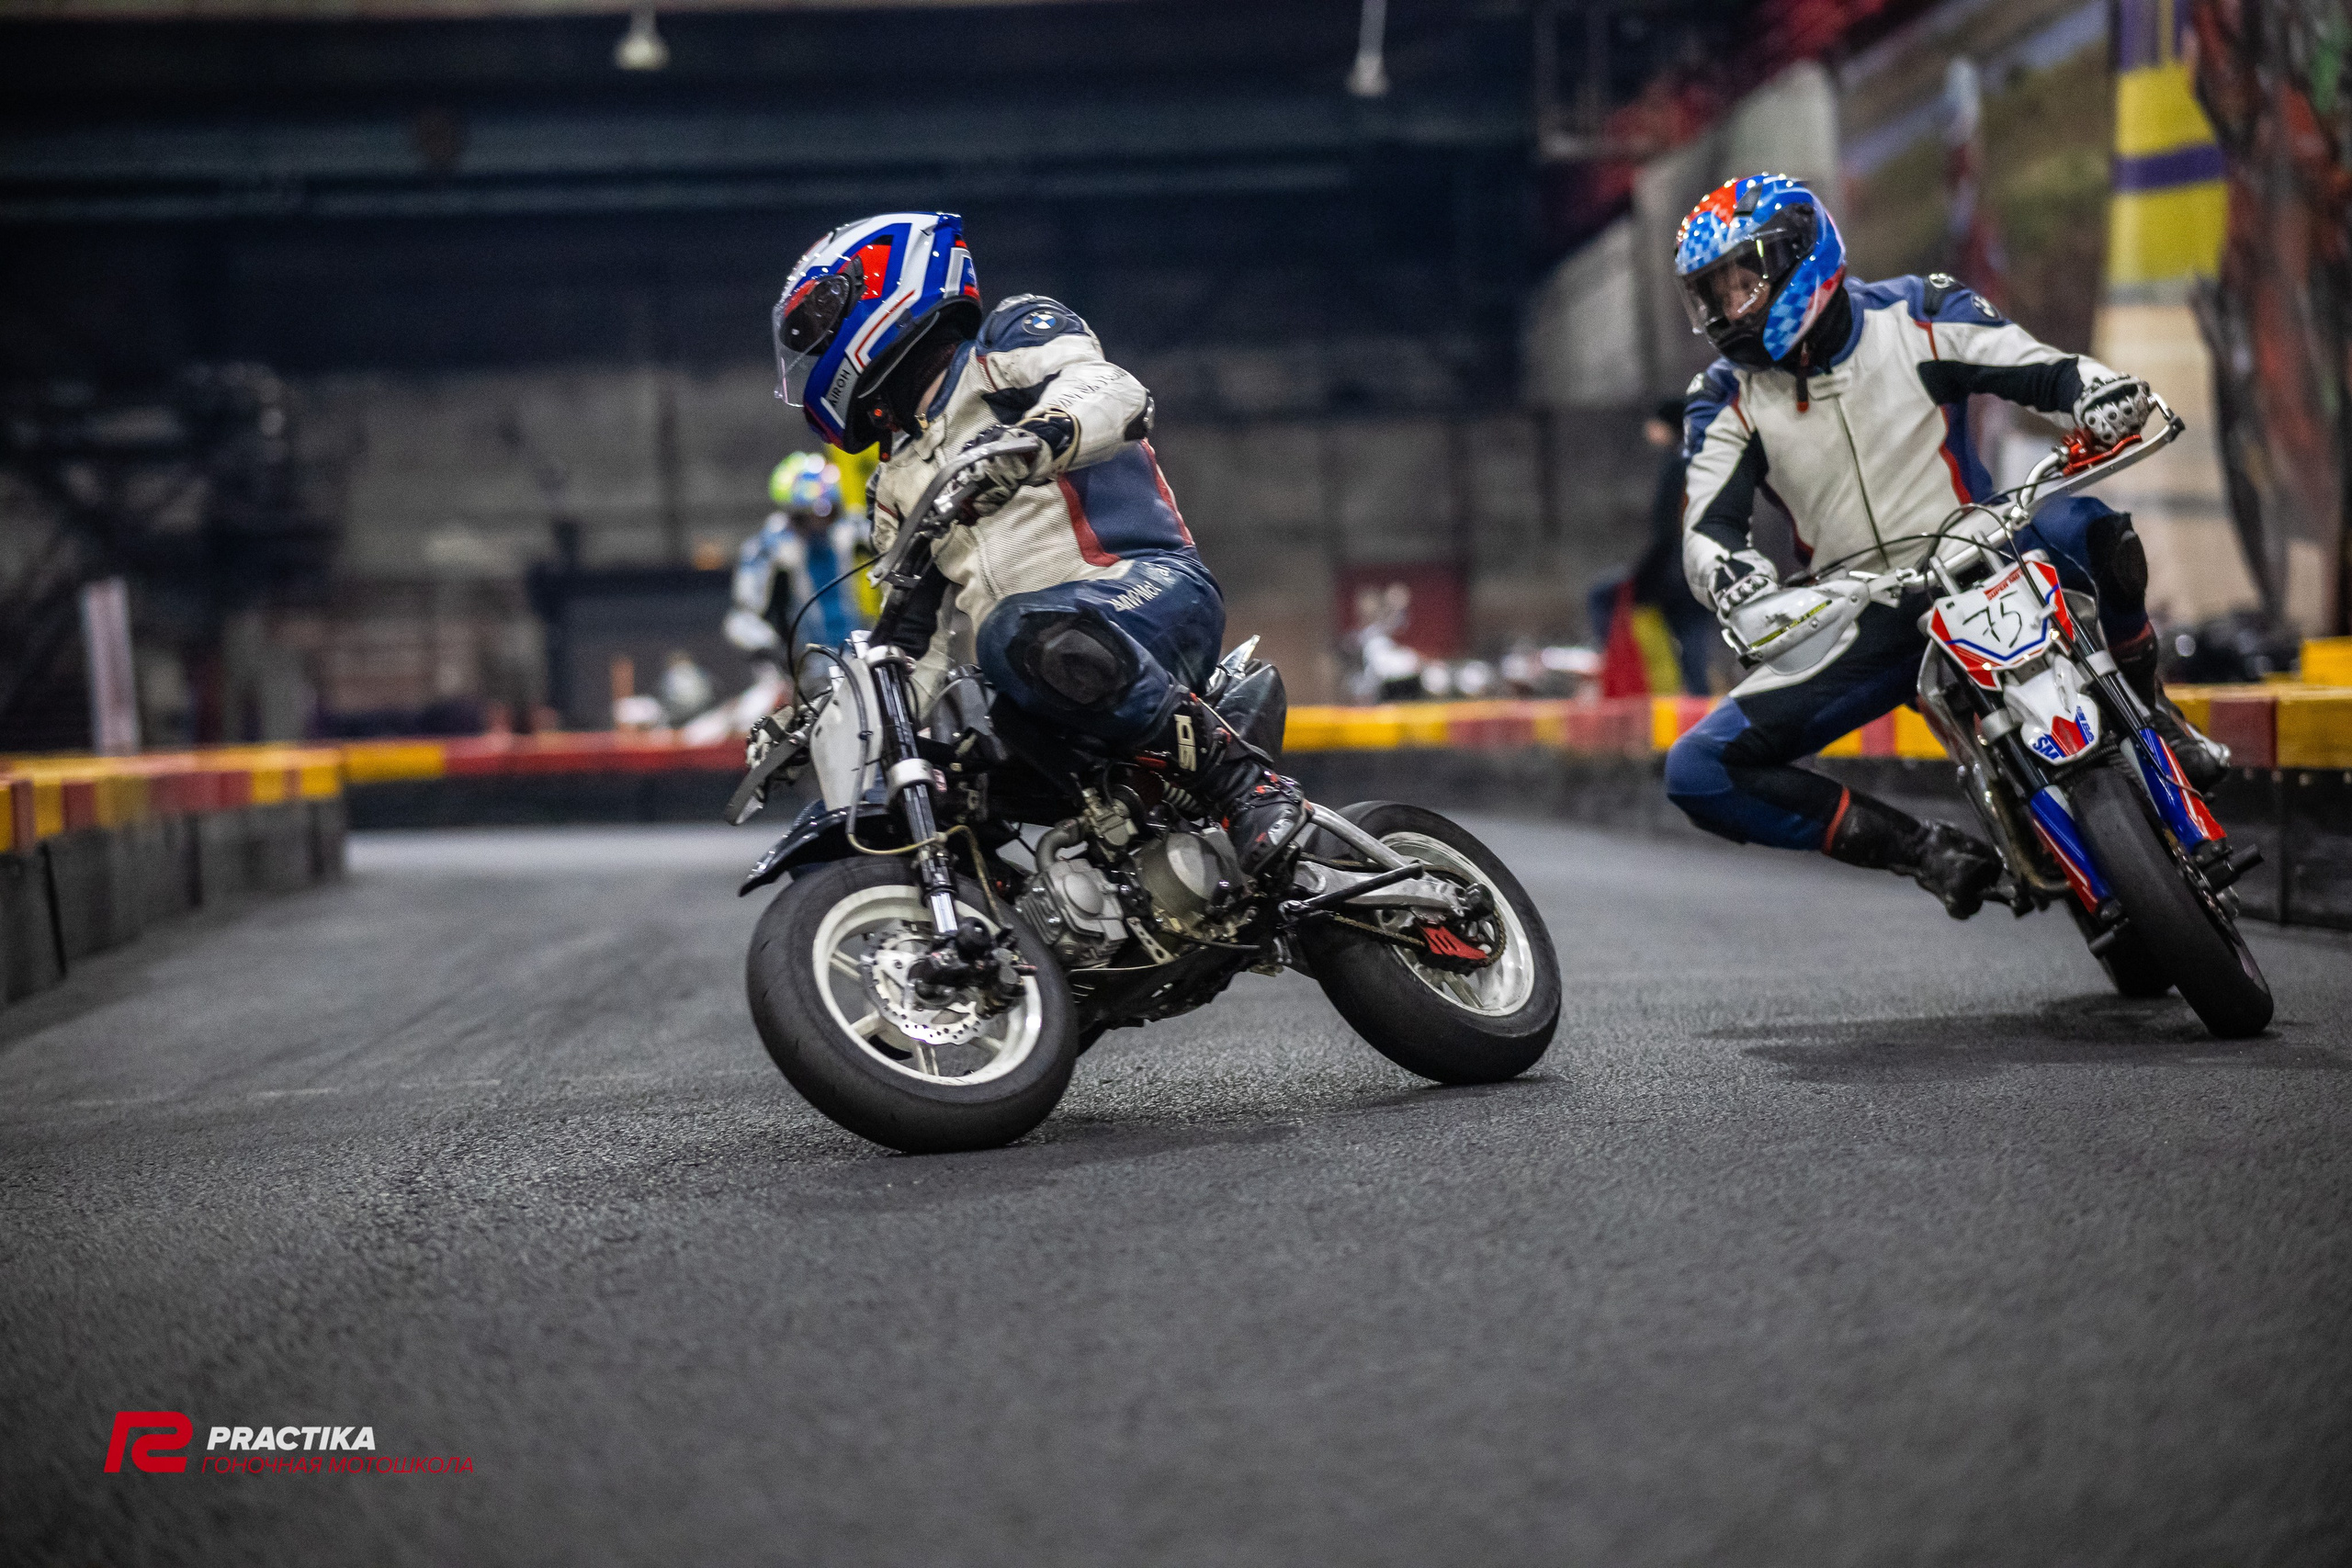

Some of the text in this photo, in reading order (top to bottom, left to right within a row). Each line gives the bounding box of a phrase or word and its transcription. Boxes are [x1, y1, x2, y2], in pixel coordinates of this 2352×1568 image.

[829, 368, 852, 408] AIROH
[1962, 590, 2022, 649] 75
[2031, 736, 2060, 761] SM
